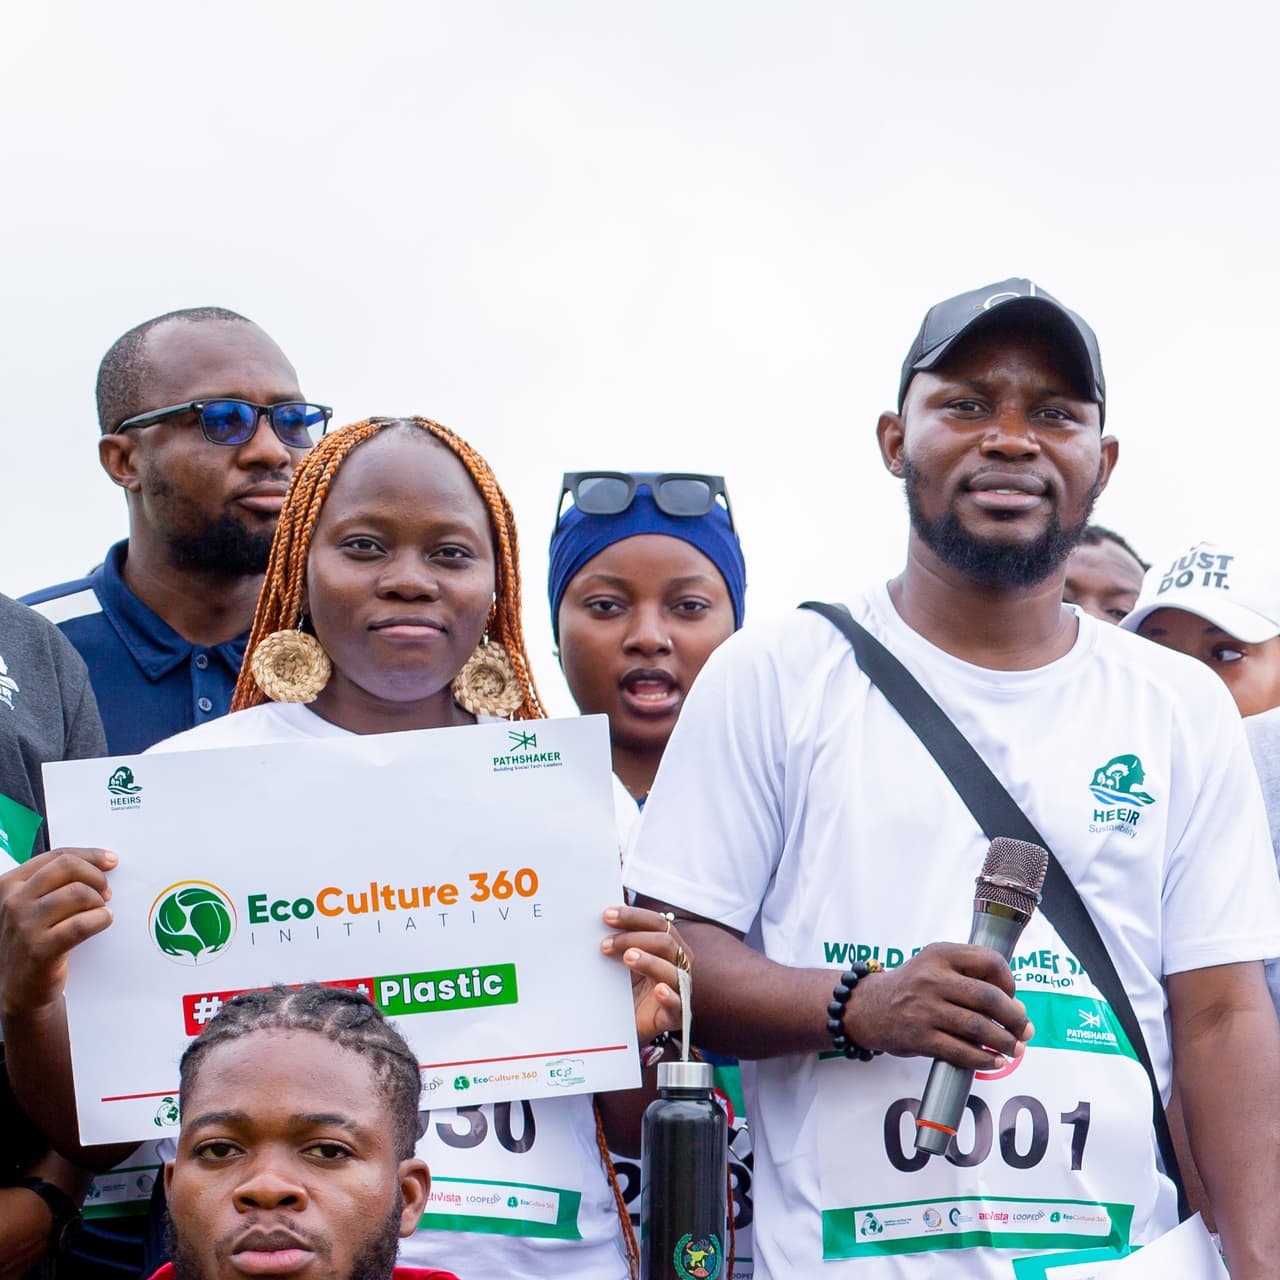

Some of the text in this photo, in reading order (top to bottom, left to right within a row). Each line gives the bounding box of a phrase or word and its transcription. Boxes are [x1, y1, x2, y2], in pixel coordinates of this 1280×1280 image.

[1163, 551, 1234, 578] JUST
[1157, 570, 1230, 595] DO IT.
[493, 751, 561, 766] PATHSHAKER
[110, 795, 142, 806] HEEIRS
[1093, 808, 1141, 826] HEEIR
[247, 867, 540, 925] EcoCulture 360
[250, 902, 543, 946] INITIATIVE
[823, 942, 901, 969] WORLD
[379, 967, 504, 1007] Plastic
[473, 1072, 520, 1085] EcoCulture
[883, 1094, 1091, 1173] 0001
[466, 1195, 495, 1206] LOOPED
[1012, 1212, 1041, 1221] LOOPED
